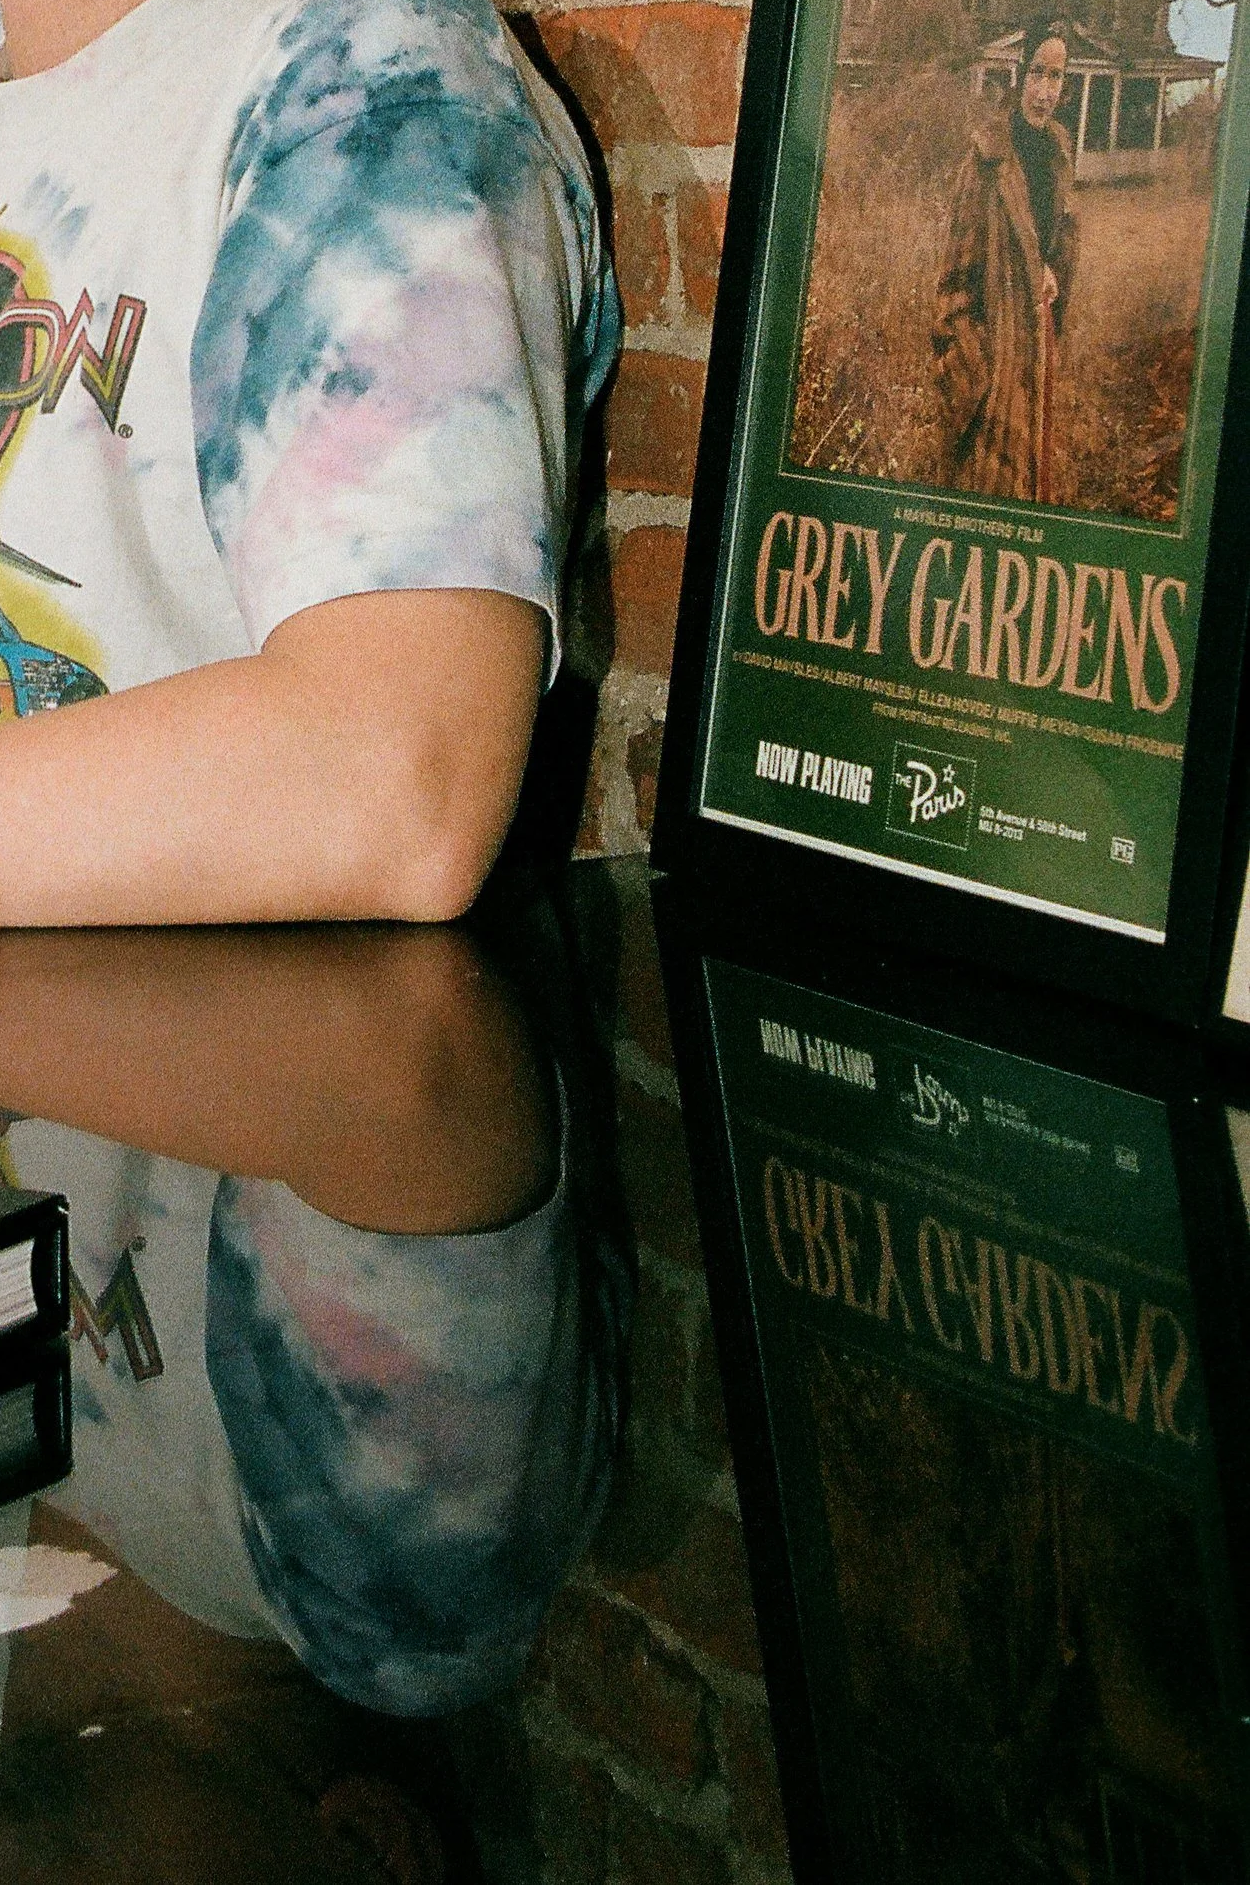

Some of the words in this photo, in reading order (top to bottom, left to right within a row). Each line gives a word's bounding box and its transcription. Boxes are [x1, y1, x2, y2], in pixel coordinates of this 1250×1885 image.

[753, 510, 903, 656] GREY
[908, 536, 1188, 715] GARDENS
[755, 740, 799, 786] NOW
[799, 751, 872, 805] PLAYING
[906, 760, 966, 824] Paris
